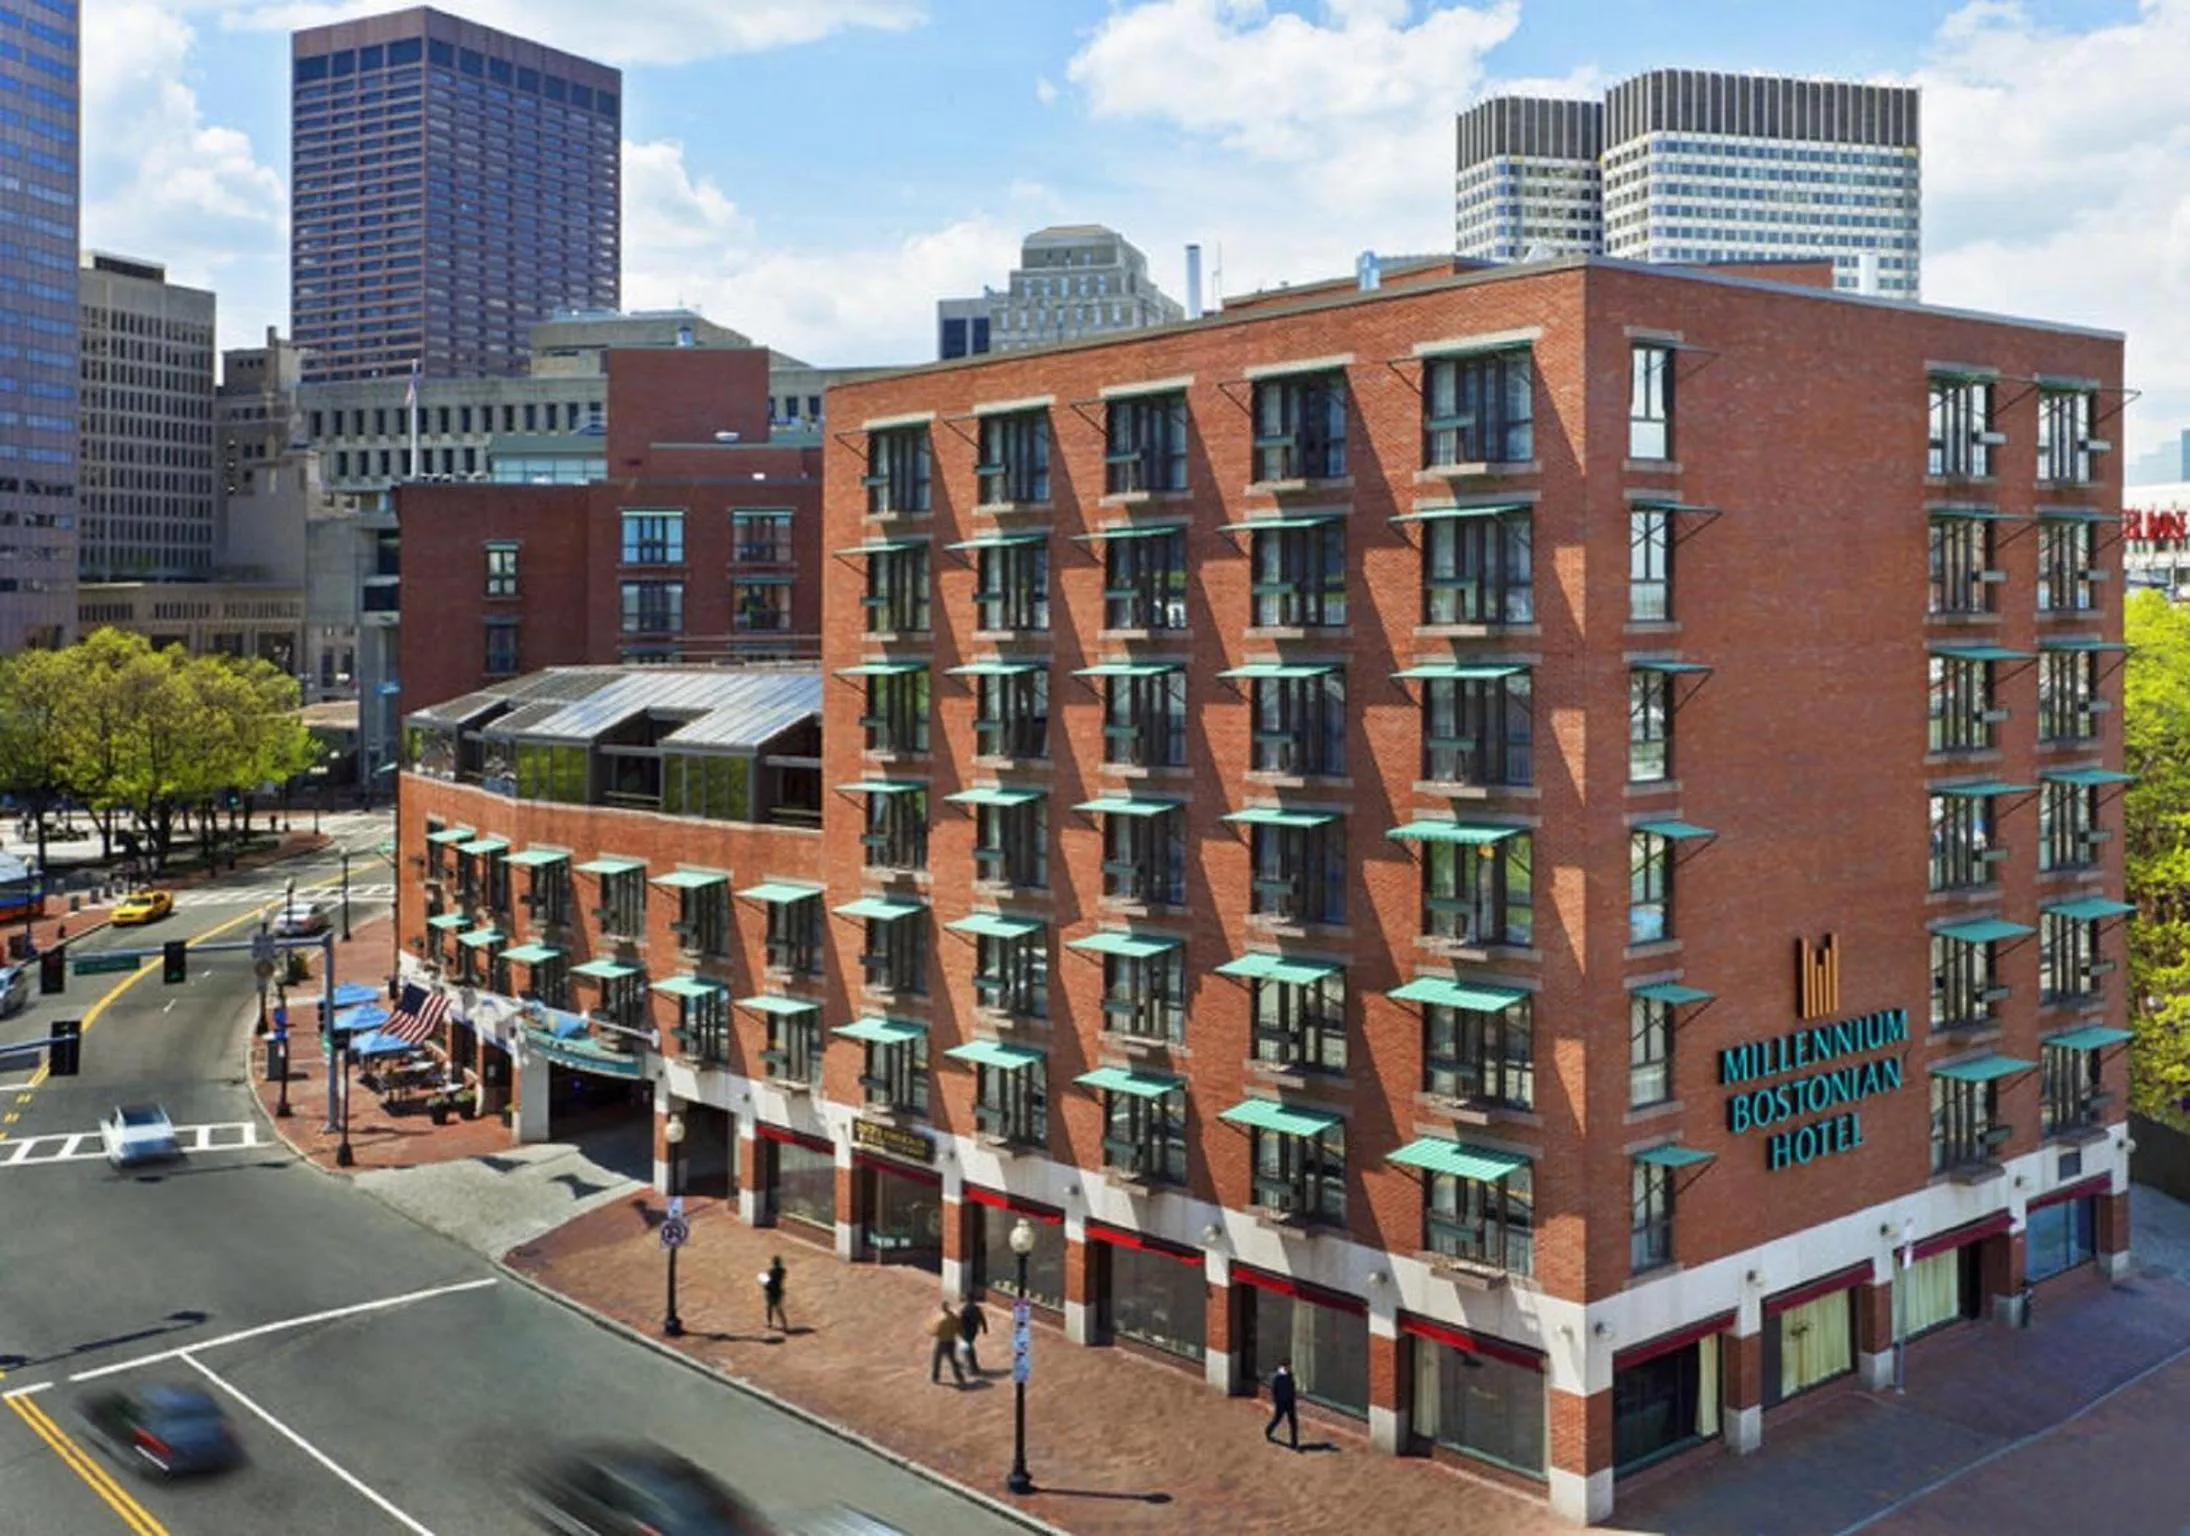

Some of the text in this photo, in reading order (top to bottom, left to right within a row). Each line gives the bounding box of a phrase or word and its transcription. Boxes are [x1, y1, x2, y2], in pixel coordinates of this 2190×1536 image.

[1720, 1009, 1908, 1086] MILLENNIUM
[1729, 1057, 1902, 1134] BOSTONIAN
[1769, 1112, 1864, 1171] HOTEL
